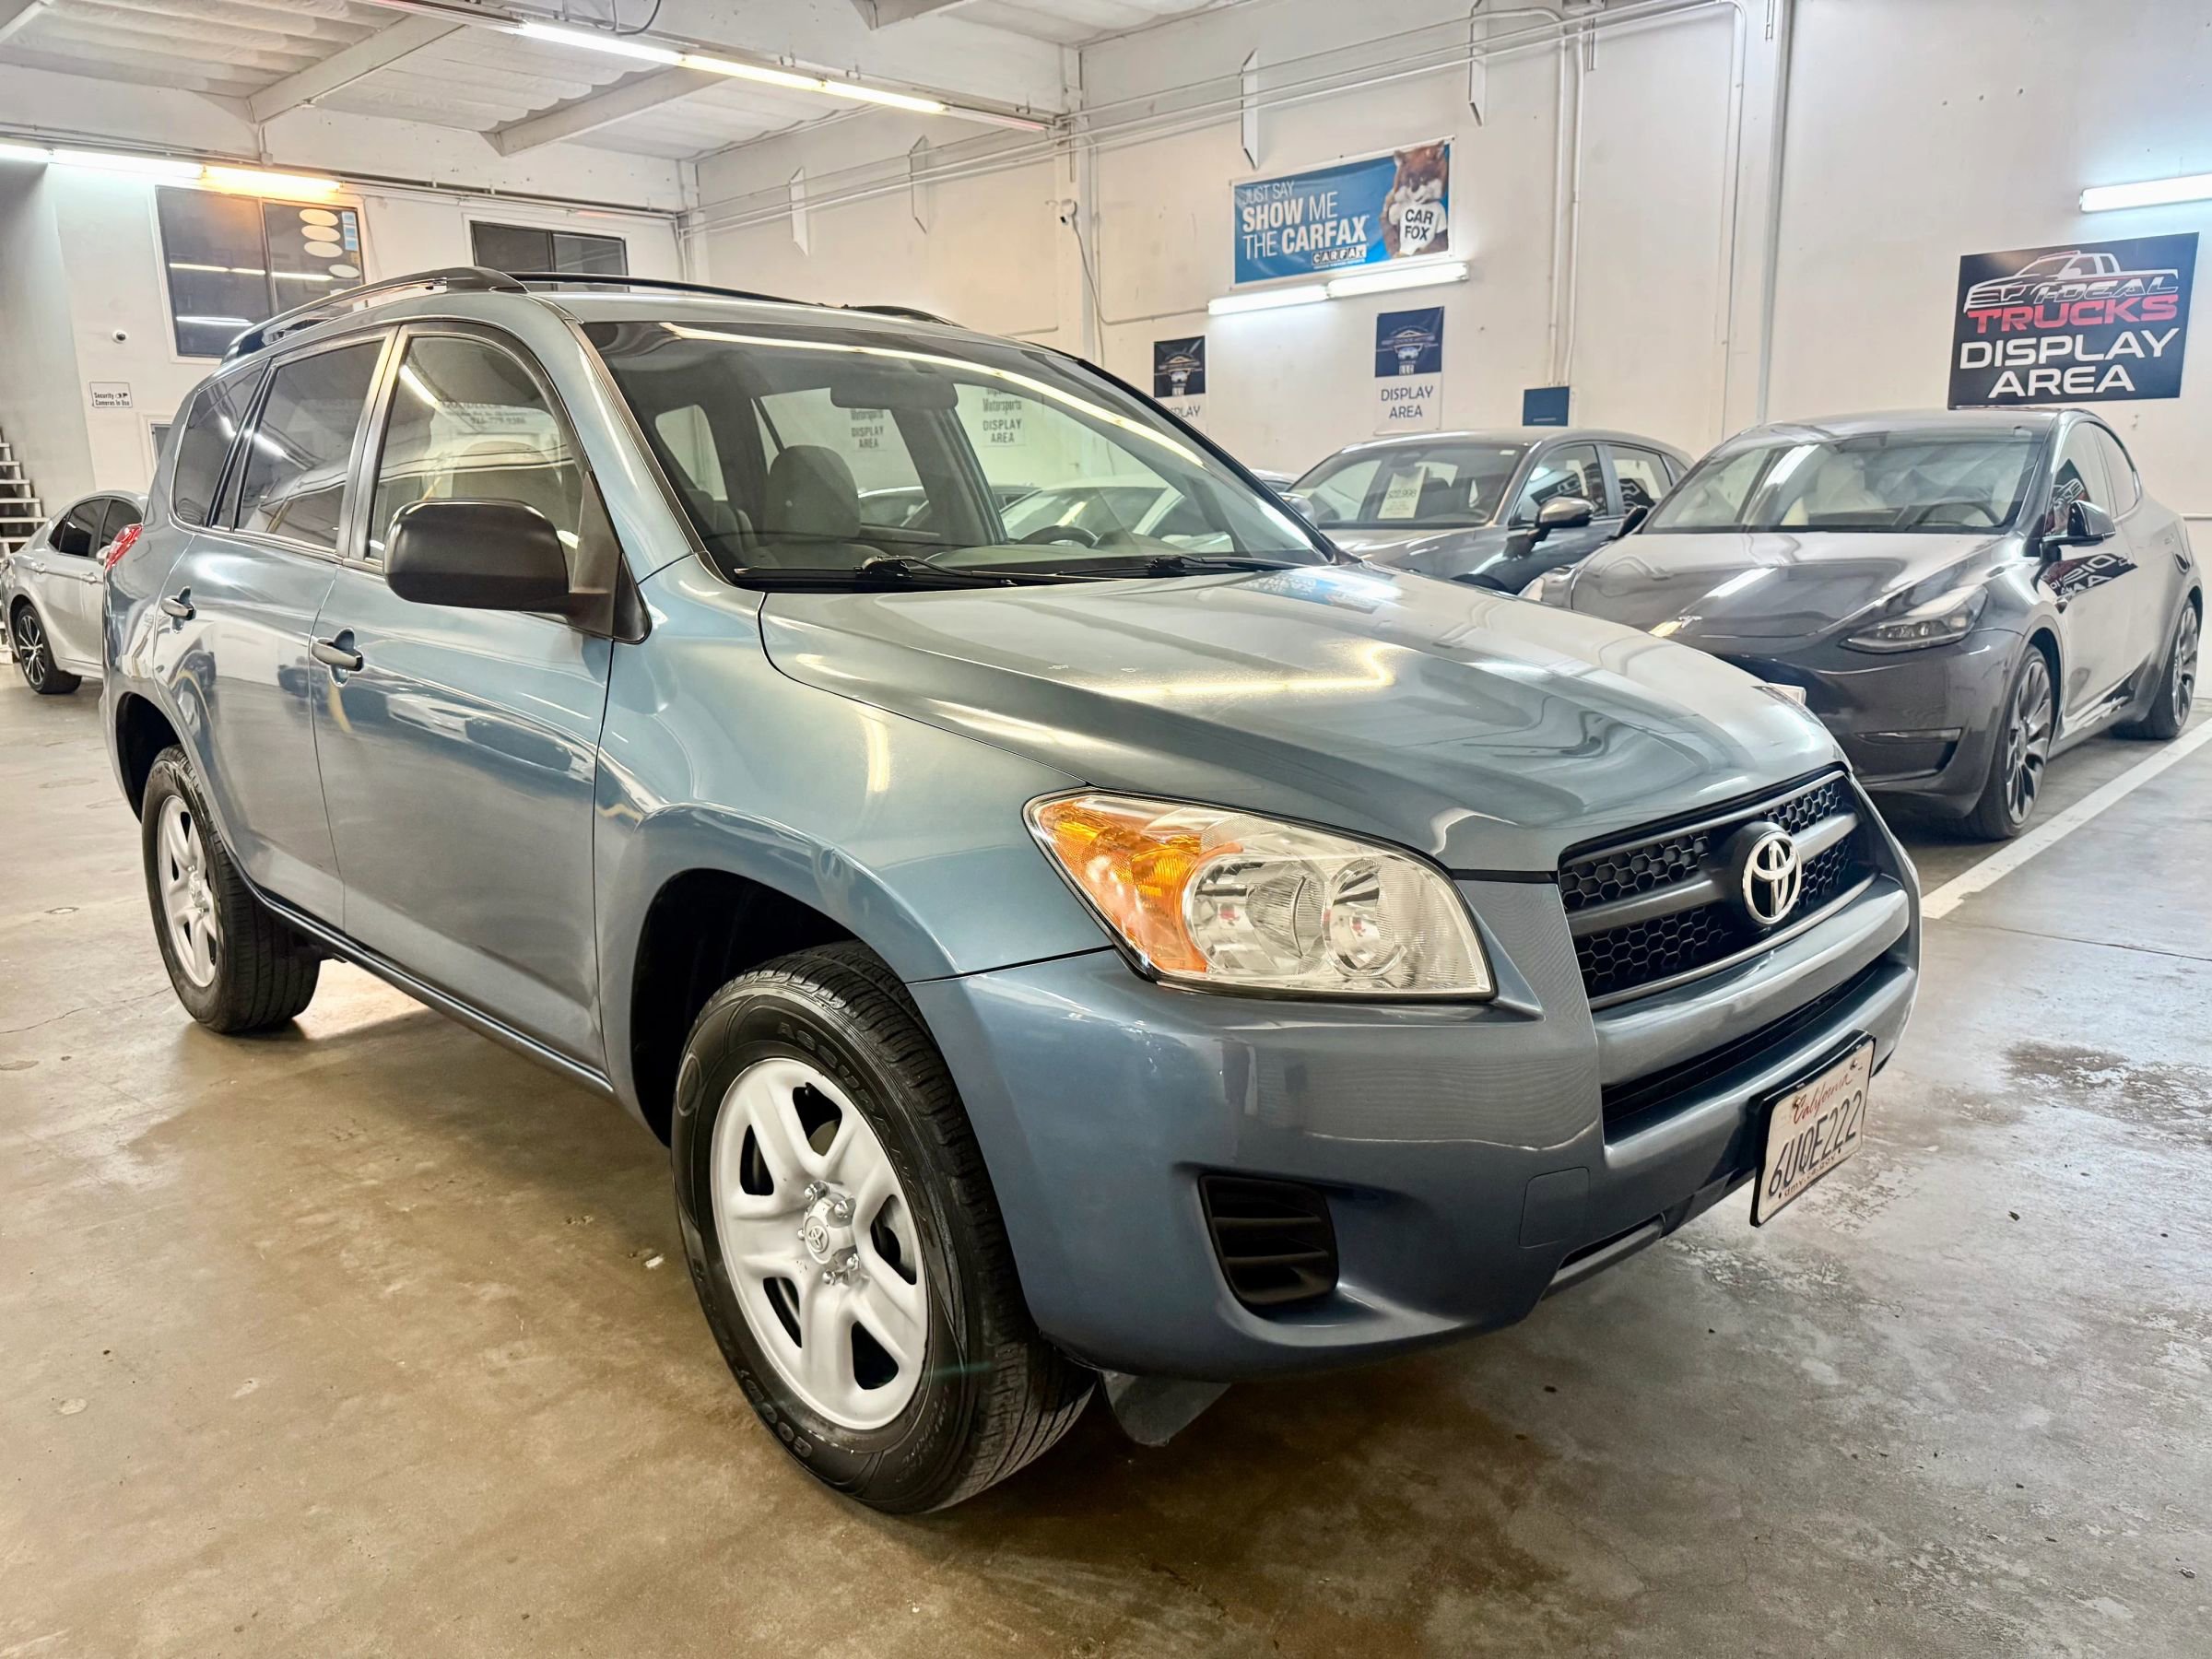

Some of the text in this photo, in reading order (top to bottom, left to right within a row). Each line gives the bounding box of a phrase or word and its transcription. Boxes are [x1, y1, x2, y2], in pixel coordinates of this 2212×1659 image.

[1242, 181, 1295, 205] JUST SAY
[1242, 192, 1338, 232] SHOW ME
[1406, 209, 1434, 225] CAR
[1242, 217, 1368, 260] THE CARFAX
[1405, 226, 1430, 241] FOX
[1312, 244, 1367, 265] CARFAX
[2033, 276, 2179, 304] I-DEAL
[1967, 294, 2179, 334] TRUCKS
[1959, 328, 2180, 369] DISPLAY
[1987, 364, 2136, 398] AREA
[94, 392, 113, 400] Security
[1381, 385, 1433, 402] DISPLAY
[982, 398, 1022, 415] Motorsports
[1389, 406, 1423, 419] AREA
[851, 425, 884, 437] DISPLAY
[982, 418, 1022, 431] DISPLAY
[859, 438, 878, 449] AREA
[991, 432, 1015, 443] AREA
[1794, 1073, 1853, 1124] California
[1768, 1089, 1863, 1197] 6UQE222
[1784, 1155, 1836, 1197] dmv.ca.gov
